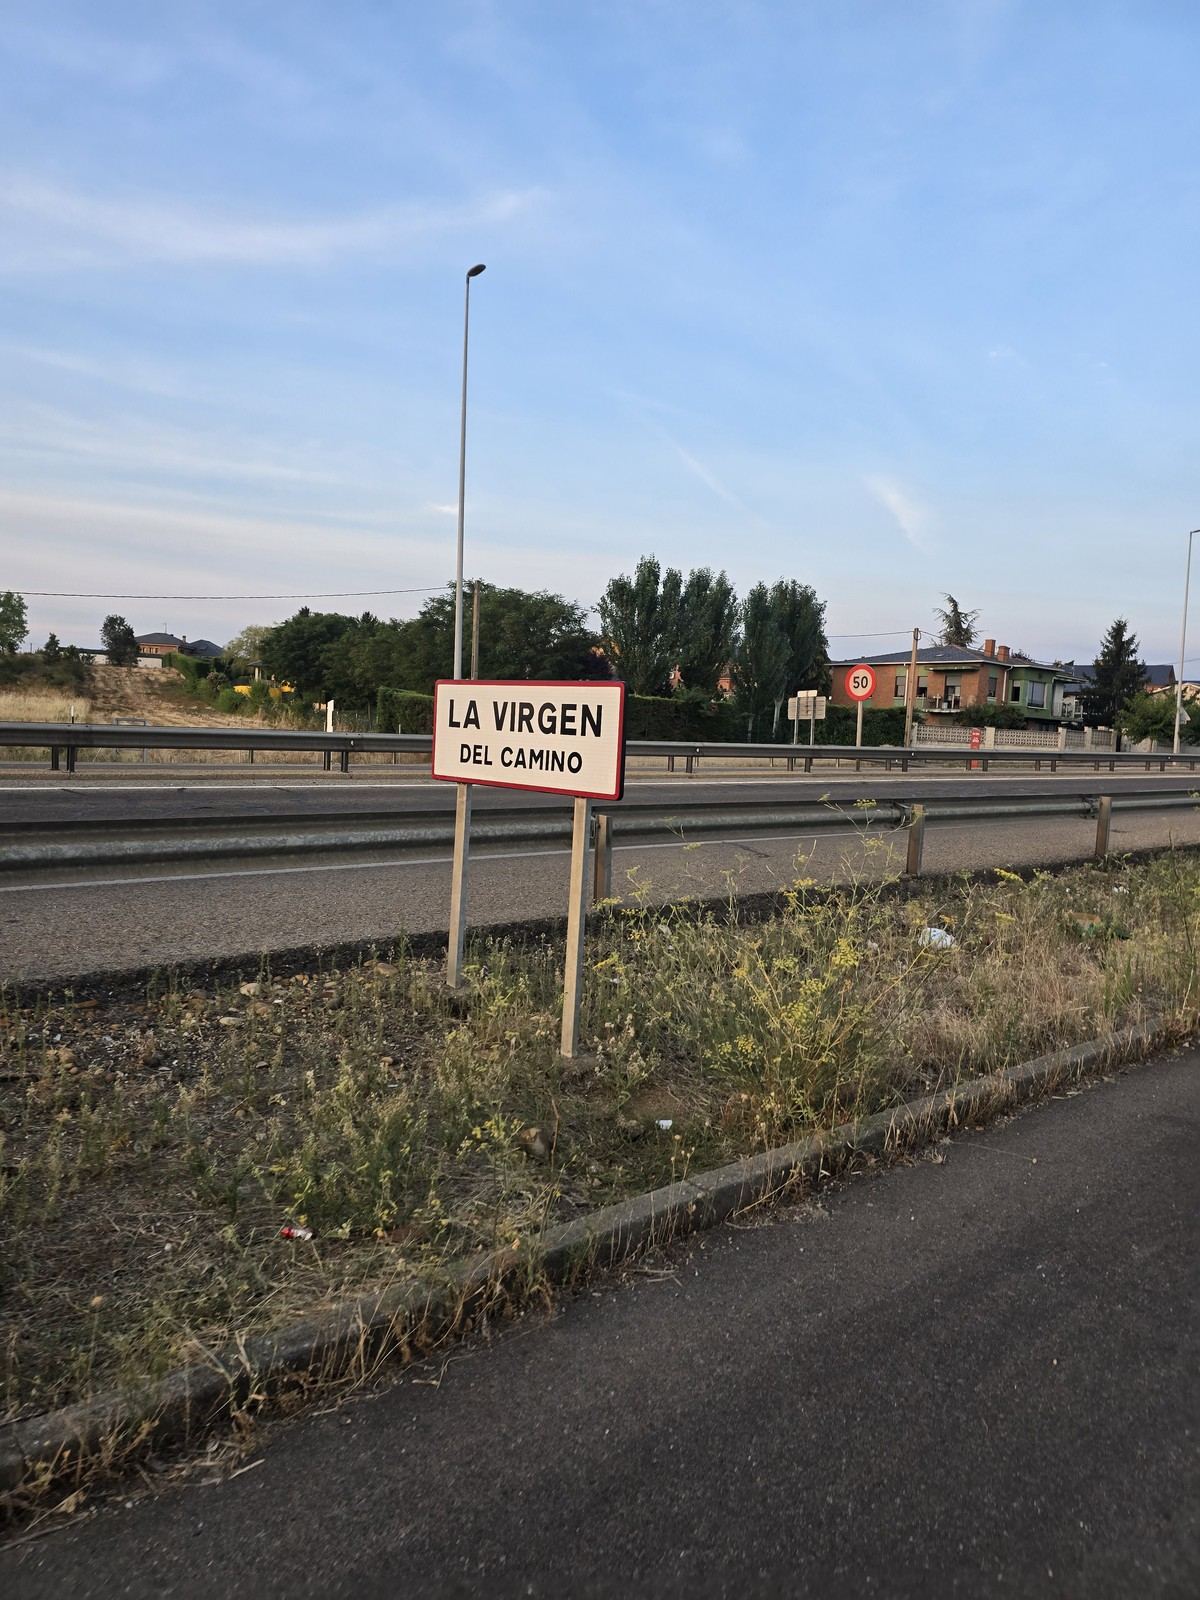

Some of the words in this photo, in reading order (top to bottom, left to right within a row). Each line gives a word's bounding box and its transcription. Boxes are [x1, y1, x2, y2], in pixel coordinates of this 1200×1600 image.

[853, 676, 869, 689] 50
[448, 699, 481, 730] LA
[493, 701, 603, 737] VIRGEN
[460, 744, 493, 765] DEL
[501, 747, 583, 774] CAMINO
